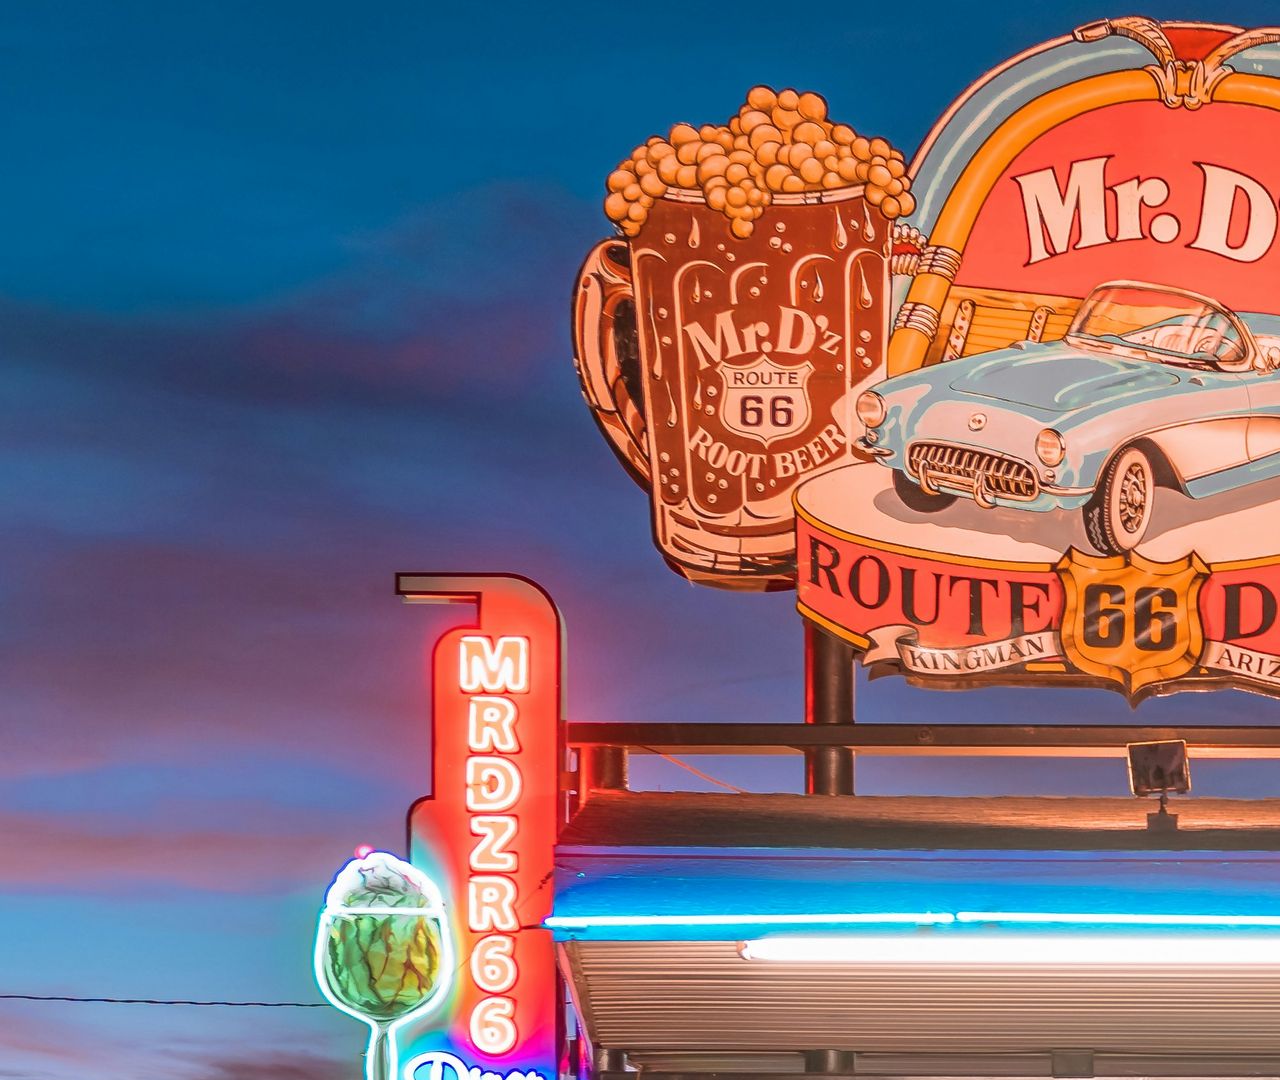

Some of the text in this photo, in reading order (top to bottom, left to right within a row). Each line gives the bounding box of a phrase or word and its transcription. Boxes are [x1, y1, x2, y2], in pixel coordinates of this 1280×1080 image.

[1011, 154, 1181, 267] Mr.
[683, 305, 843, 371] Mr. D'z
[733, 371, 799, 386] ROUTE
[739, 395, 794, 428] 66
[689, 423, 847, 479] ROOT BEER
[808, 534, 1054, 640] ROUTE
[1082, 582, 1178, 651] 66
[910, 636, 1046, 671] KINGMAN
